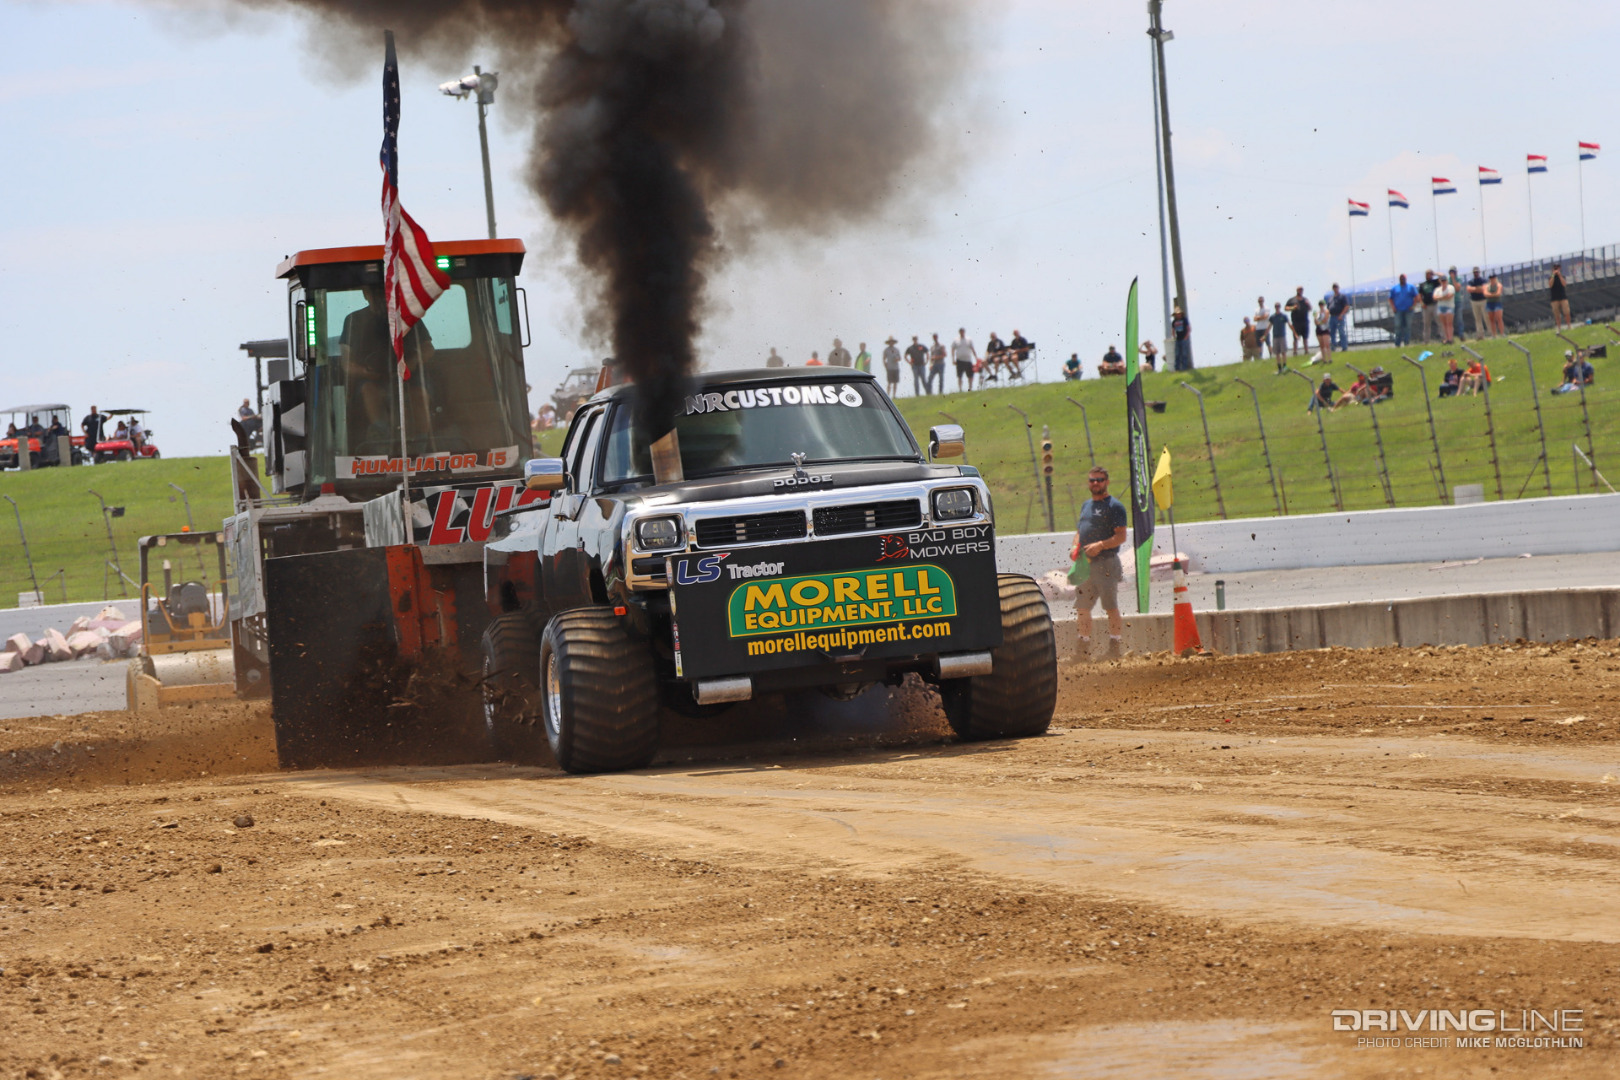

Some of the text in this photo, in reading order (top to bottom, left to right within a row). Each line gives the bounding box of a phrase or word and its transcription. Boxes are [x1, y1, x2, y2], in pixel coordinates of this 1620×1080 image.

[351, 450, 507, 475] HUMILIATOR 15
[773, 474, 833, 488] DODGE
[908, 525, 990, 545] BAD BOY
[910, 540, 991, 559] MOWERS
[676, 556, 722, 585] LS
[726, 560, 785, 580] Tractor
[743, 570, 941, 611] MORELL
[744, 596, 943, 630] EQUIPMENT, LLC
[747, 621, 951, 655] morellequipment.com
